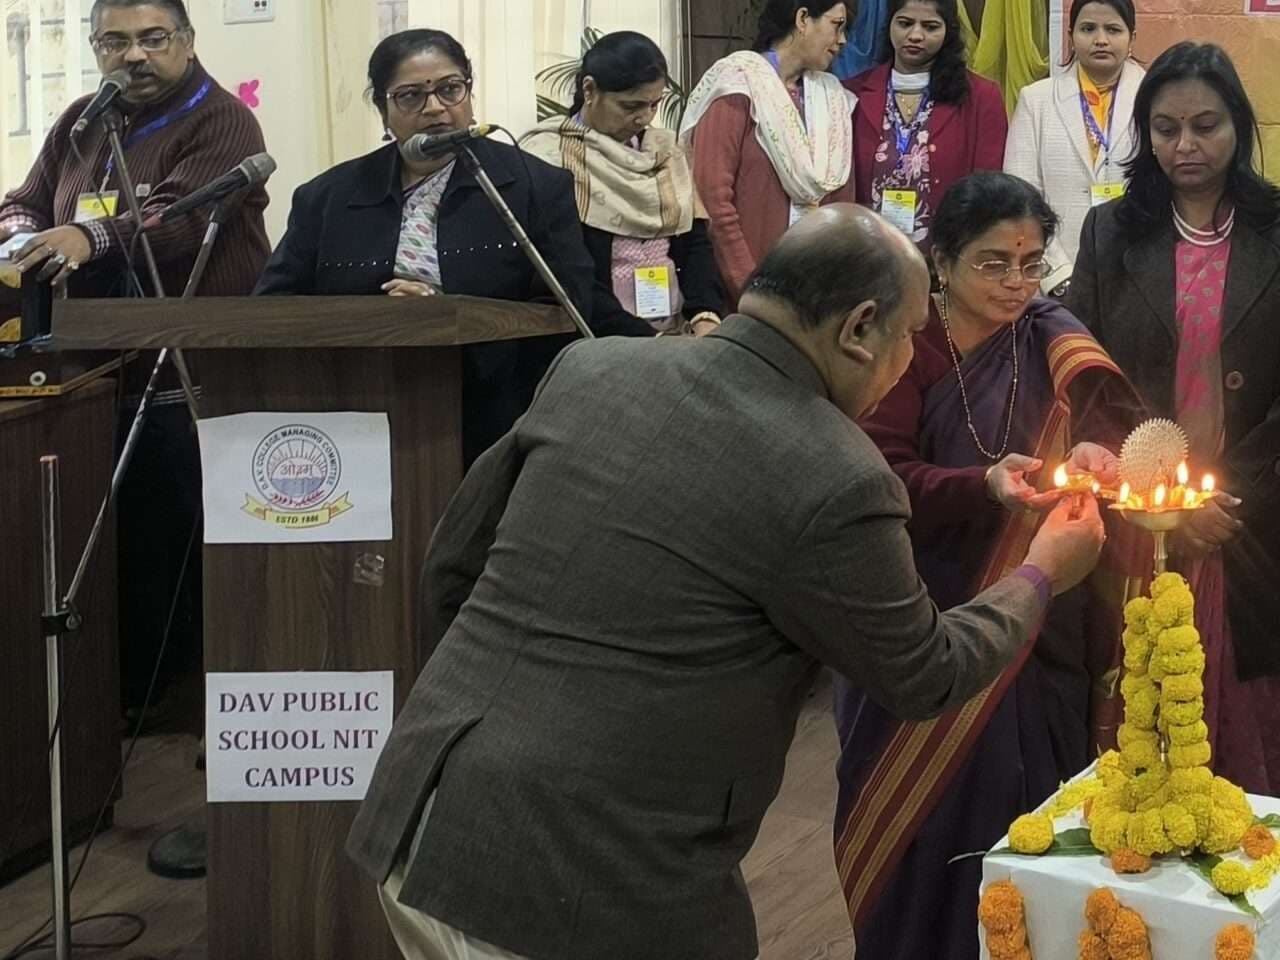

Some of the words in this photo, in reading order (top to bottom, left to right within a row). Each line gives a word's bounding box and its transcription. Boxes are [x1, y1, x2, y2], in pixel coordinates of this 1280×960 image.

[218, 692, 275, 713] DAV
[282, 691, 380, 713] PUBLIC
[217, 730, 326, 751] SCHOOL
[332, 729, 379, 750] NIT
[244, 766, 355, 788] CAMPUS
